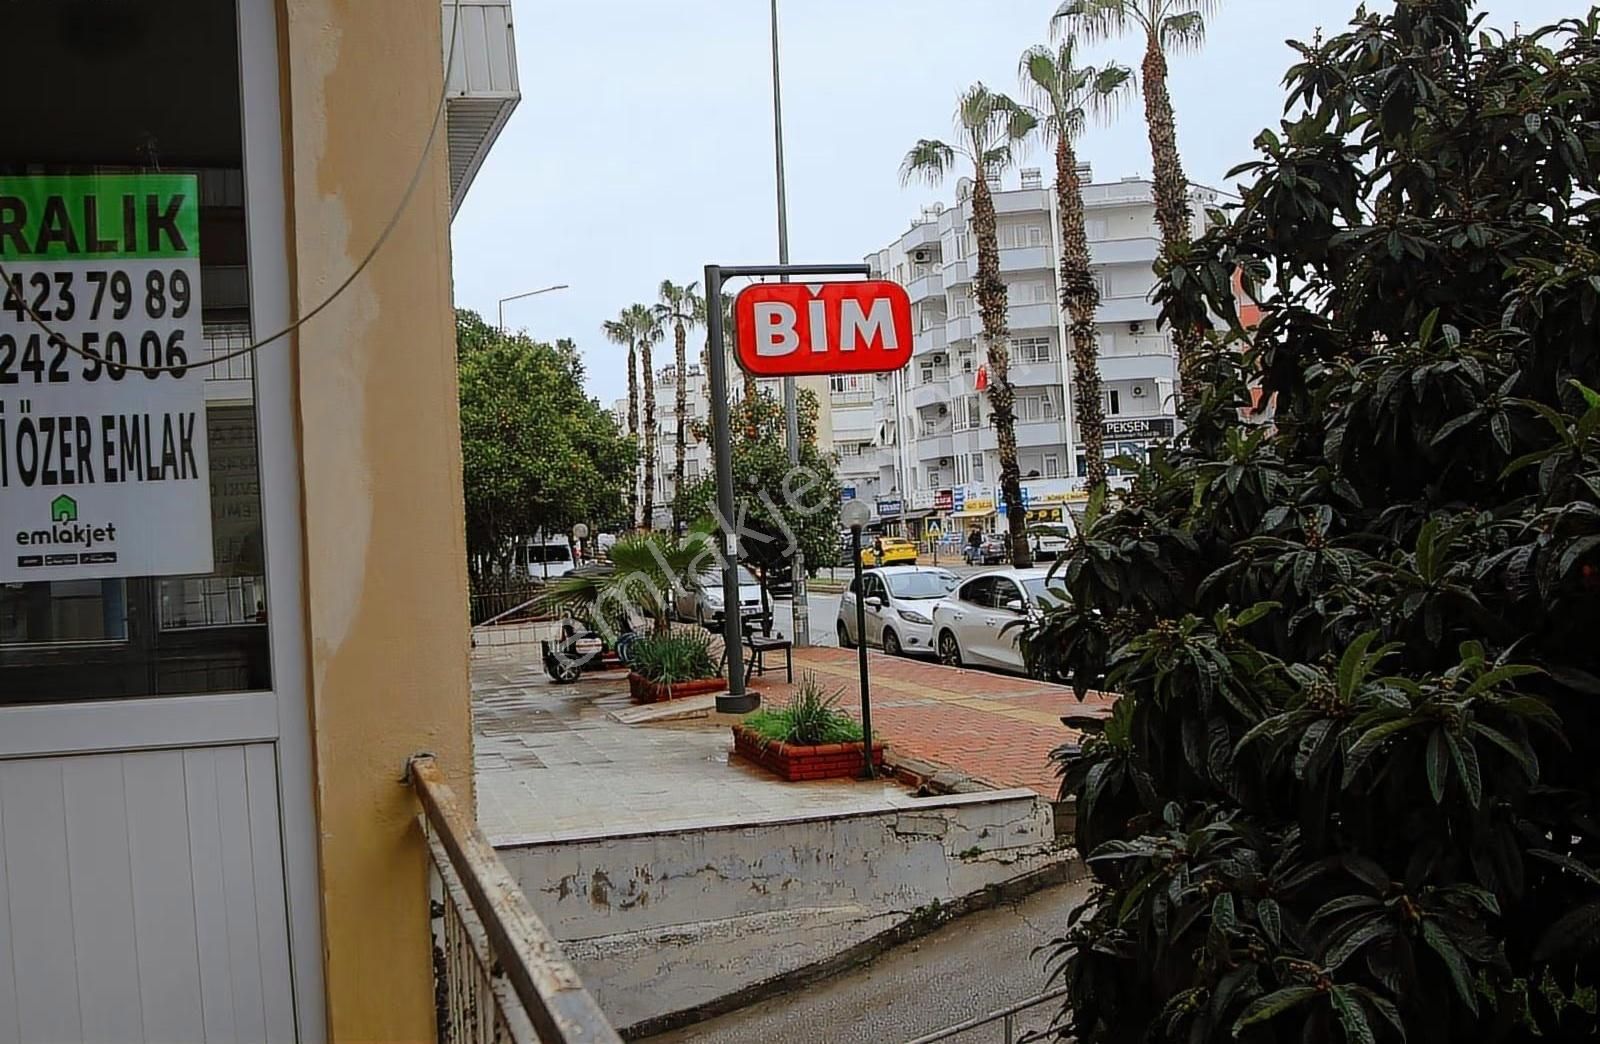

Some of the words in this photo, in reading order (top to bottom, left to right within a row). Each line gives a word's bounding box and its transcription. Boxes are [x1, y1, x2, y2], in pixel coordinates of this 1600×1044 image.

[0, 194, 188, 255] RALIK
[3, 272, 76, 322] 423
[86, 270, 132, 320] 79
[145, 269, 191, 319] 89
[753, 284, 899, 357] BİM
[0, 333, 69, 384] 242
[82, 331, 127, 381] 50
[140, 329, 187, 380] 06
[16, 400, 95, 487] ÖZER
[101, 412, 199, 482] EMLAK
[16, 522, 117, 548] emlakjet
